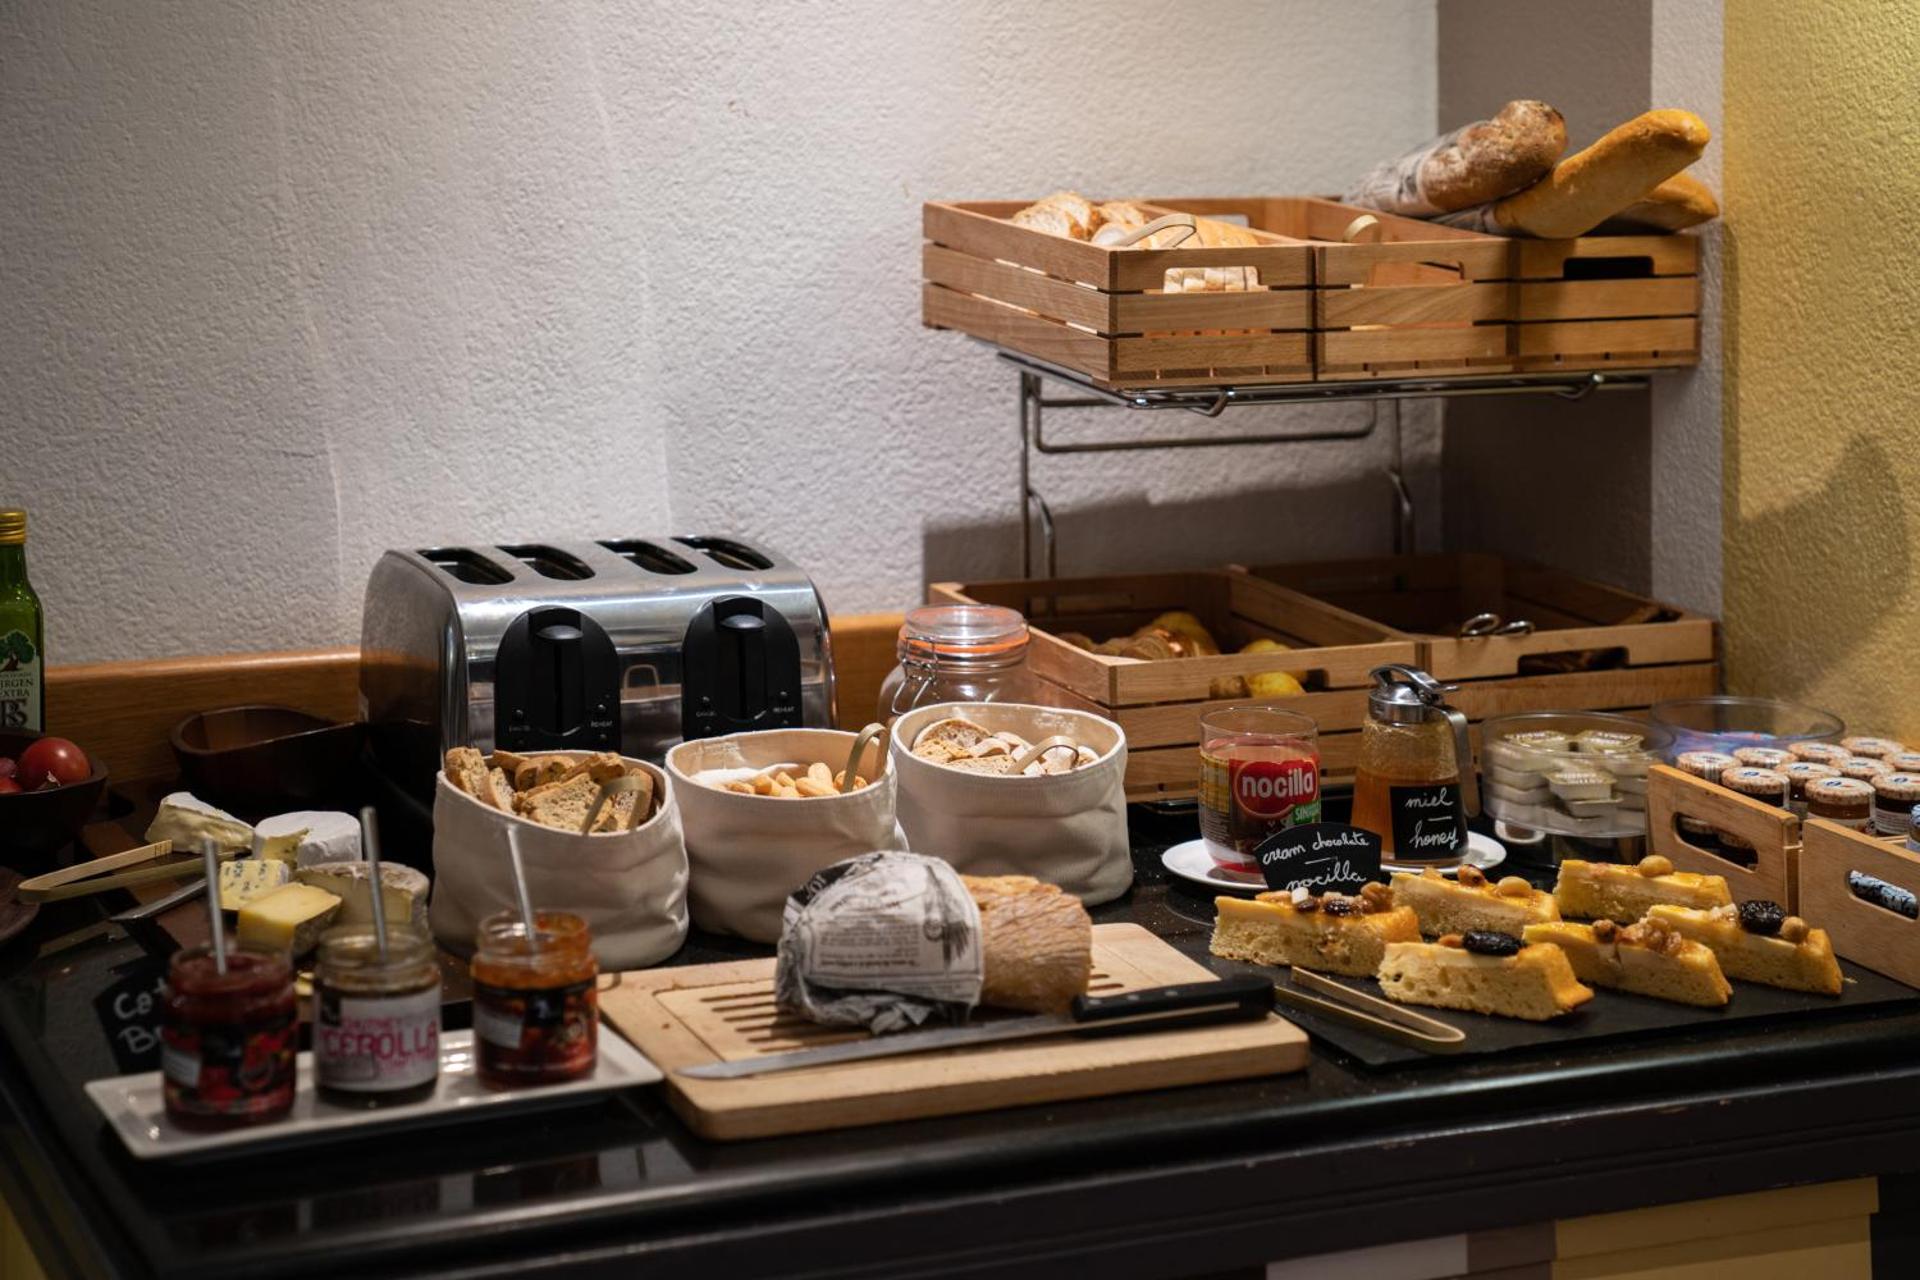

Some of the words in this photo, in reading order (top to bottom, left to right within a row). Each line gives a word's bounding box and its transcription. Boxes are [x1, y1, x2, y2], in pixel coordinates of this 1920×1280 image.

[0, 679, 33, 688] IRGEN
[1242, 768, 1314, 798] nocilla
[1404, 786, 1455, 808] miel
[1408, 819, 1459, 850] honey
[1262, 843, 1306, 865] cream
[1285, 859, 1367, 891] nocilla
